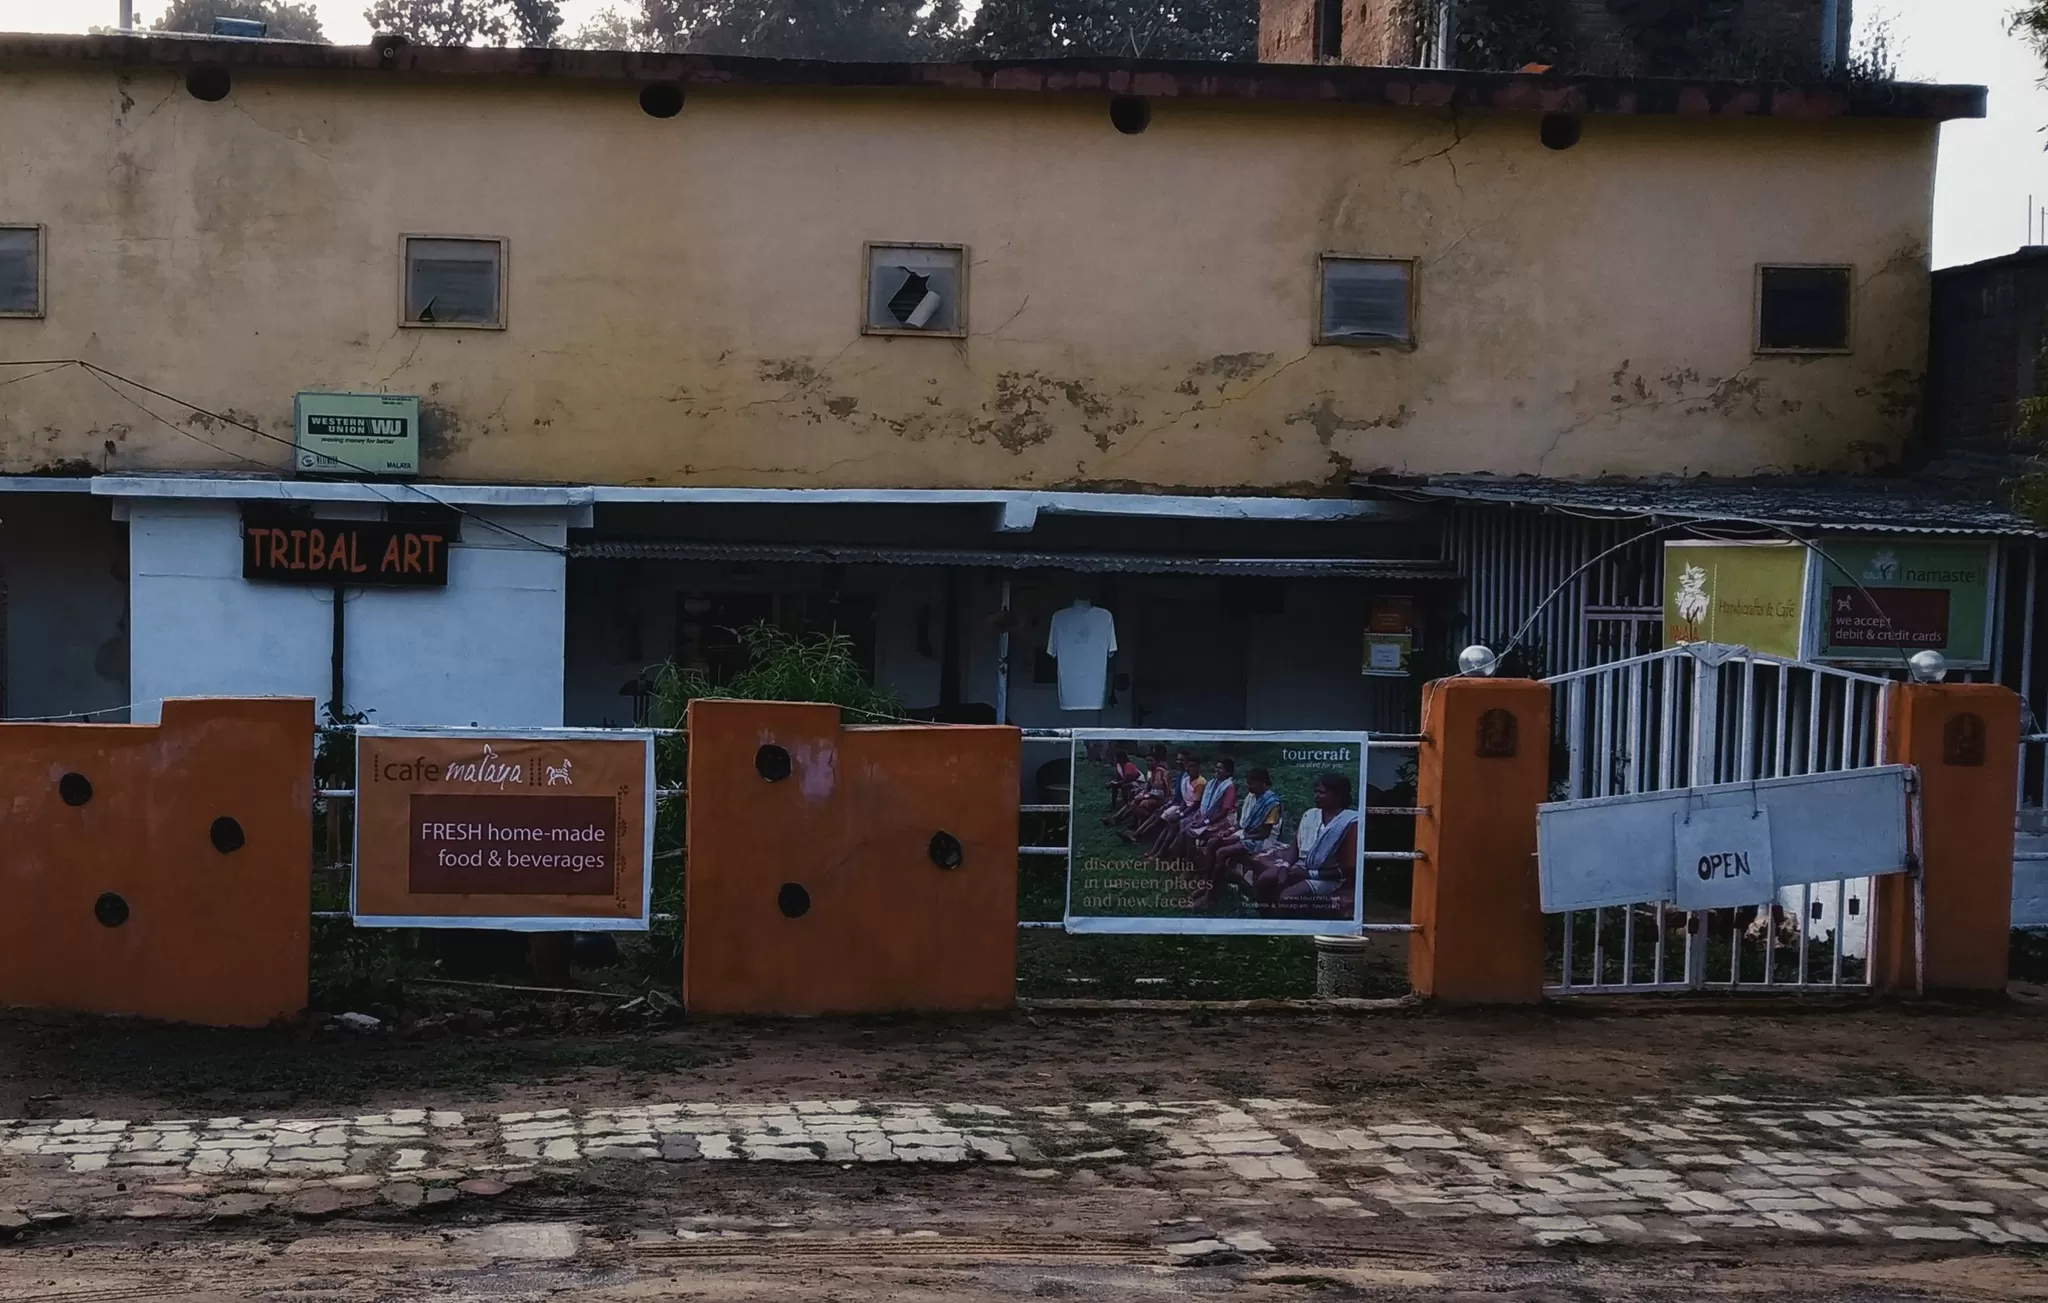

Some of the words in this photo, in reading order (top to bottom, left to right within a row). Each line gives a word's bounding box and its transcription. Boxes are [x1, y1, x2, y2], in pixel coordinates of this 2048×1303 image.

[311, 417, 365, 426] WESTERN
[372, 420, 402, 435] WU
[328, 425, 365, 434] UNION
[248, 528, 367, 573] TRIBAL
[380, 533, 443, 573] ART
[1906, 569, 1975, 583] namaste
[1766, 602, 1773, 616] &
[1836, 618, 1851, 626] we
[1854, 617, 1892, 629] accept
[1835, 629, 1862, 640] debit
[1866, 629, 1875, 640] &
[1877, 630, 1910, 641] credit
[1912, 631, 1942, 642] cards
[1282, 747, 1351, 760] tourcraft
[383, 757, 439, 783] cafe
[445, 744, 522, 790] malaya
[422, 823, 482, 840] FRESH
[488, 823, 605, 841] home-made
[438, 849, 482, 867] food
[488, 849, 501, 867] &
[507, 849, 605, 872] beverages
[1084, 858, 1149, 871] discover
[1155, 858, 1195, 871] India
[1698, 851, 1750, 880] OPEN
[1083, 878, 1098, 889] in
[1104, 878, 1160, 889] unseen
[1164, 876, 1213, 892] places
[1083, 894, 1112, 907] and
[1117, 895, 1149, 907] new
[1155, 894, 1195, 908] faces
